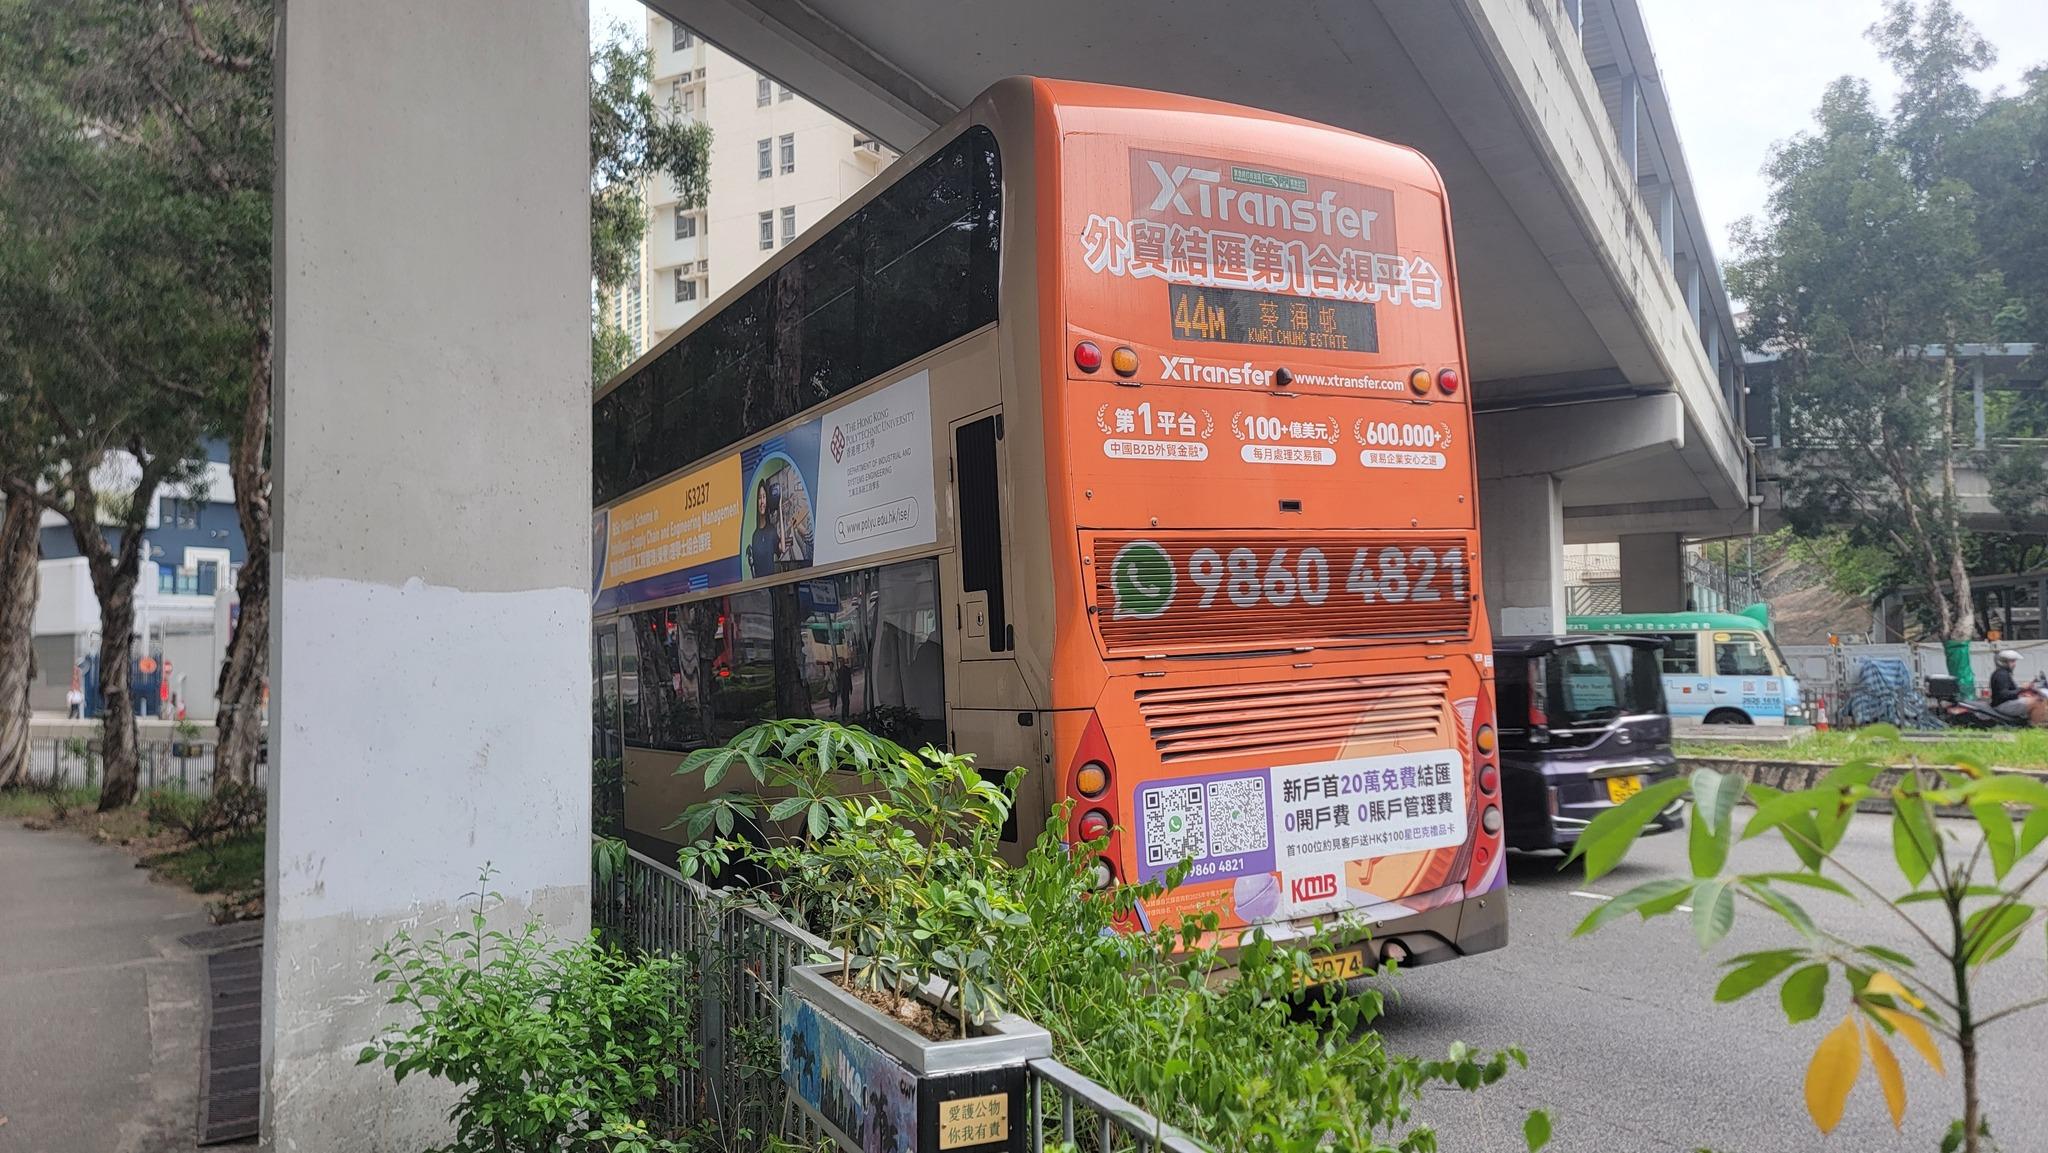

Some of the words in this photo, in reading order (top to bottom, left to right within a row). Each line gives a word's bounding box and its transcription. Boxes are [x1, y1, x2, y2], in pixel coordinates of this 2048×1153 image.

[1147, 159, 1379, 241] XTransfer
[1081, 214, 1442, 309] 外貿結匯第1合規平台
[1174, 292, 1228, 340] 44M
[1248, 327, 1274, 344] KWAI
[1277, 330, 1308, 346] CHUNG
[1310, 333, 1349, 350] ESTATE
[1159, 355, 1275, 389] XTransfer
[1294, 374, 1405, 392] www.xtransfer.com
[857, 414, 873, 430] HONG
[873, 408, 889, 422] KONG
[881, 410, 916, 432] UNIVERSITY
[1114, 402, 1198, 437] 第1平台
[1244, 415, 1329, 442] 100+億美元
[684, 482, 710, 510] JS3237
[1188, 547, 1331, 609] 9860
[1345, 545, 1468, 606] 4821
[1283, 763, 1452, 803] 新戶首20萬免費結匯
[1284, 804, 1351, 833] 0開戶費
[1218, 858, 1244, 873] 4821
[1291, 873, 1338, 904] KMB
[949, 1099, 1001, 1123] 愛護公物
[948, 1120, 1001, 1145] 你我有責
